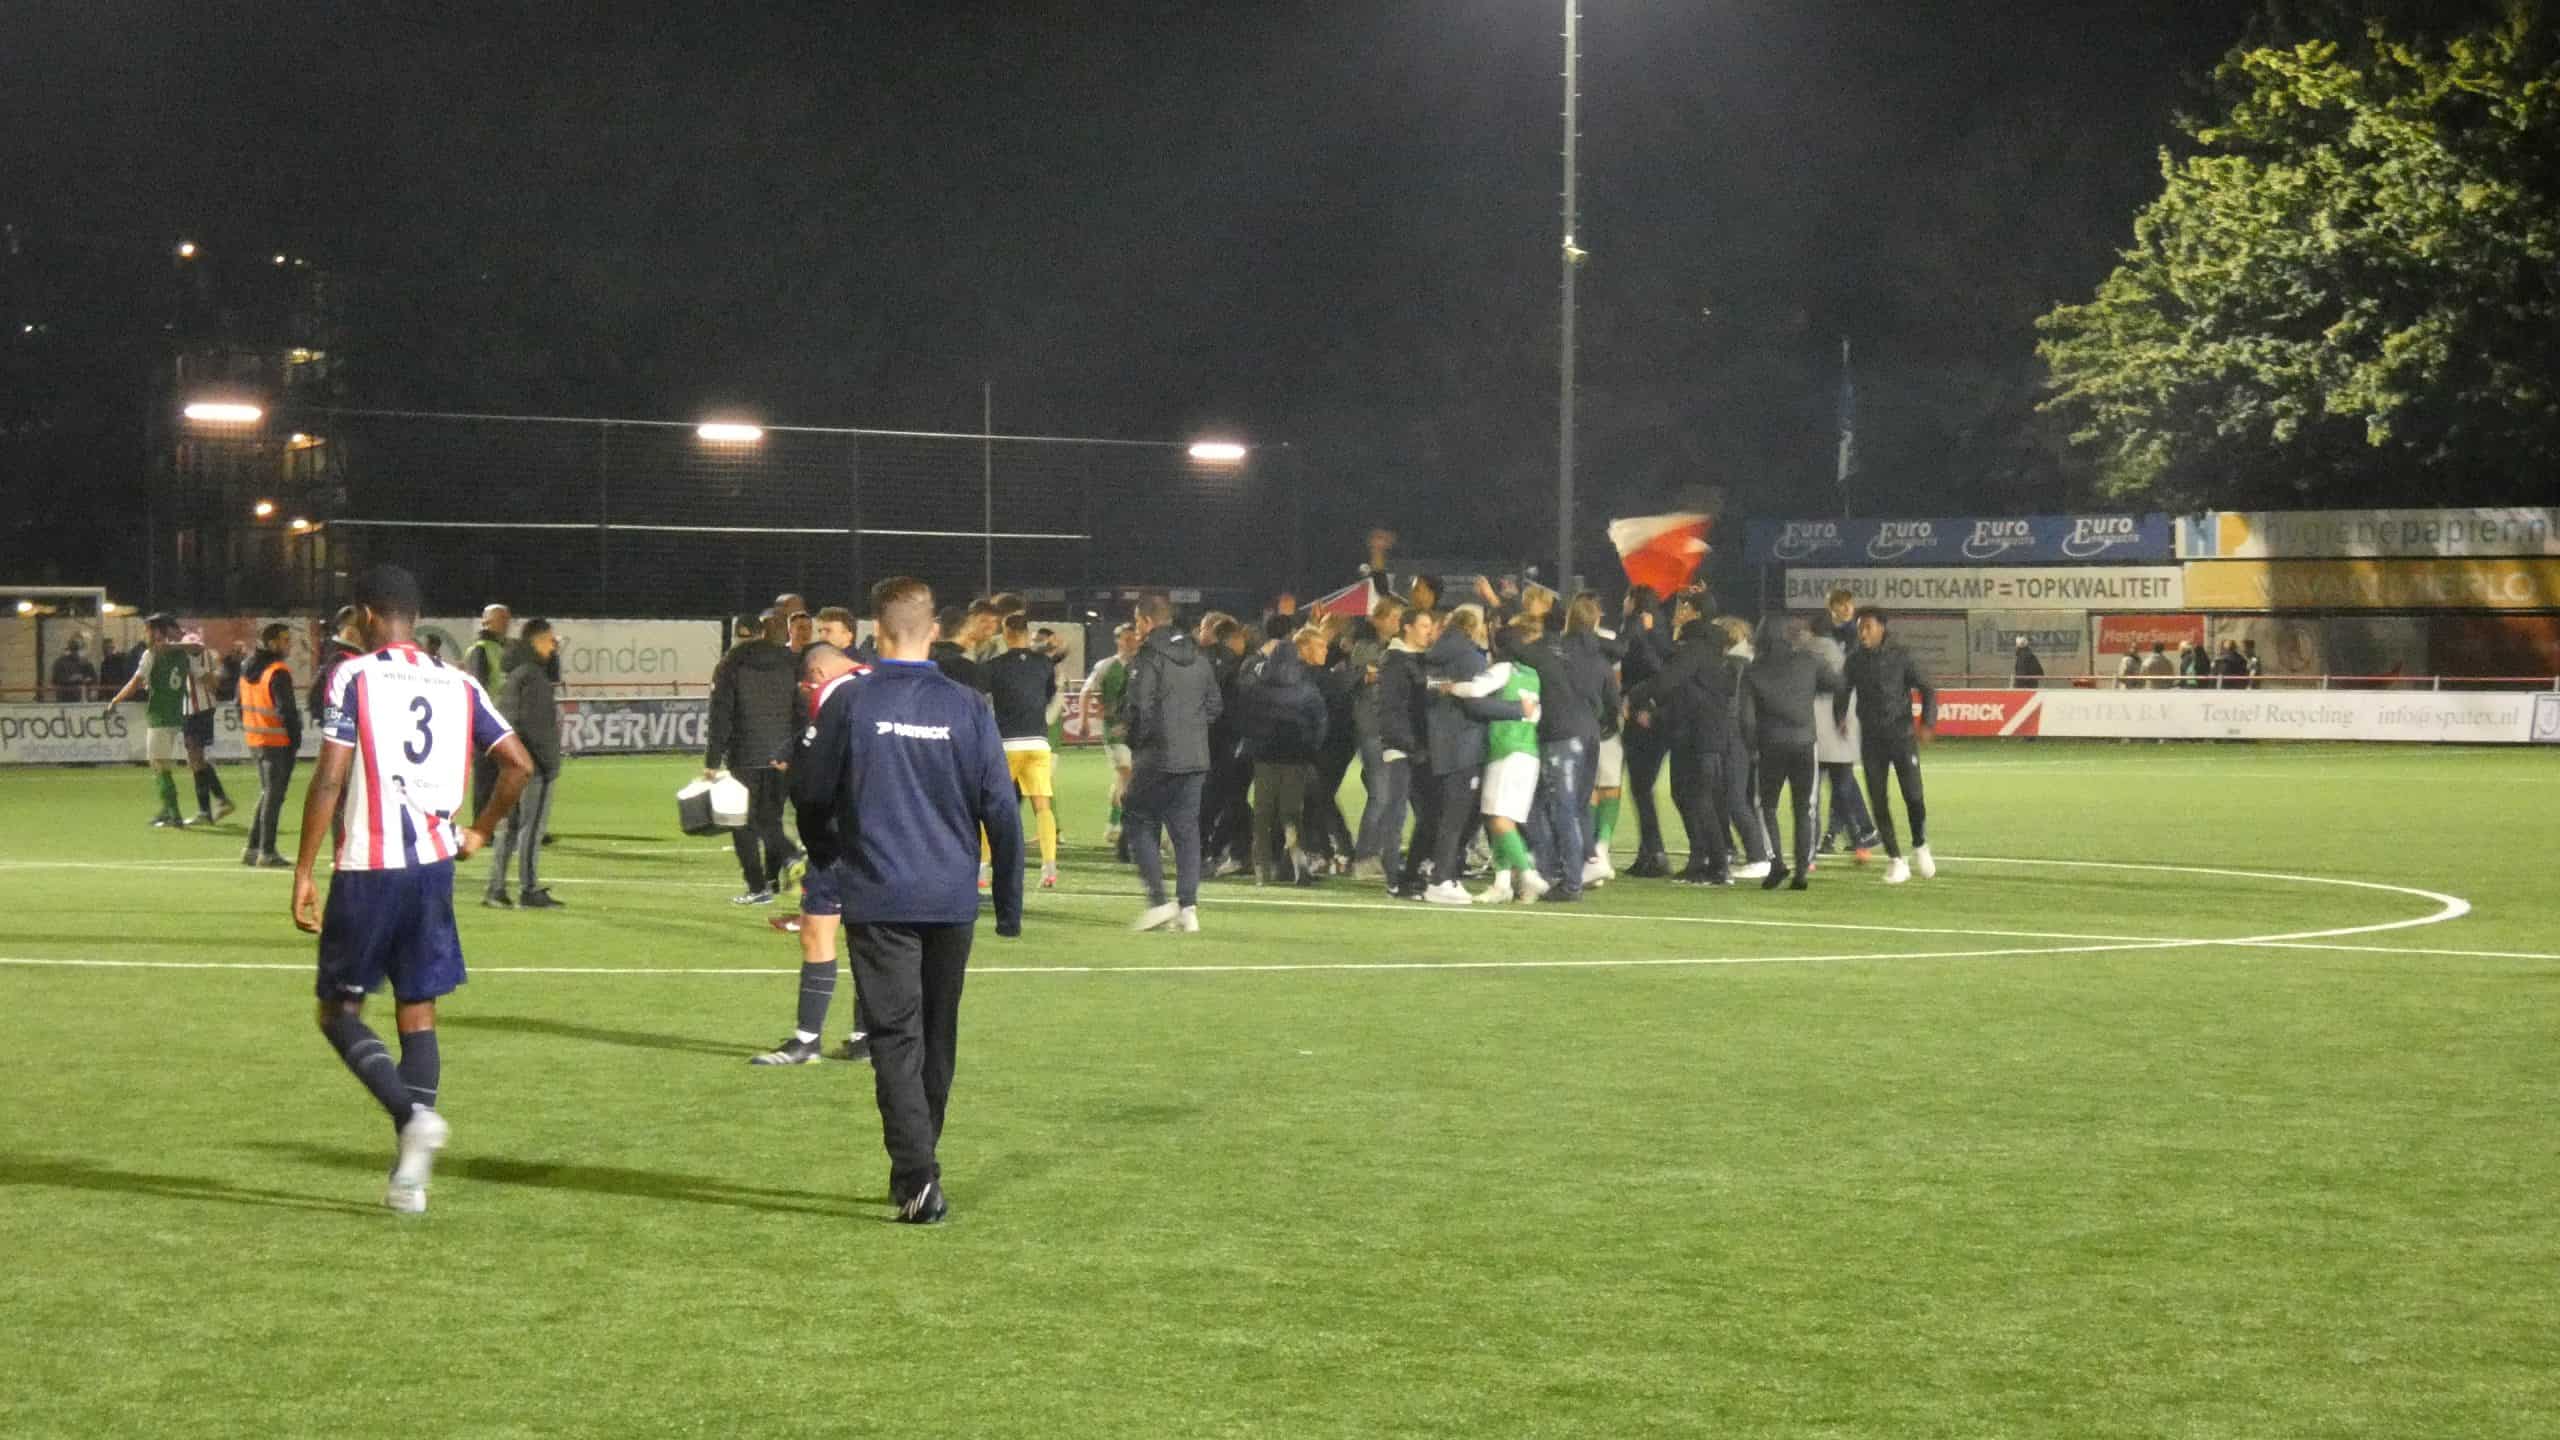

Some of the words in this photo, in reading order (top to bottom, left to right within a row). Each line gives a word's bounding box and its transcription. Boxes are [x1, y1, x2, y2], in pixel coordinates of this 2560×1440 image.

[1784, 522, 1838, 547] Euro
[1878, 521, 1932, 546] Euro
[1971, 519, 2030, 546] Euro
[2072, 517, 2134, 544] Euro
[1887, 578, 1994, 598] HOLTKAMP
[2016, 577, 2171, 598] TOPKWALITEIT
[169, 668, 182, 690] 6
[1936, 703, 2004, 721] ATRICK
[2266, 703, 2354, 727] Recycling
[1, 709, 128, 749] products
[403, 696, 433, 765] 3
